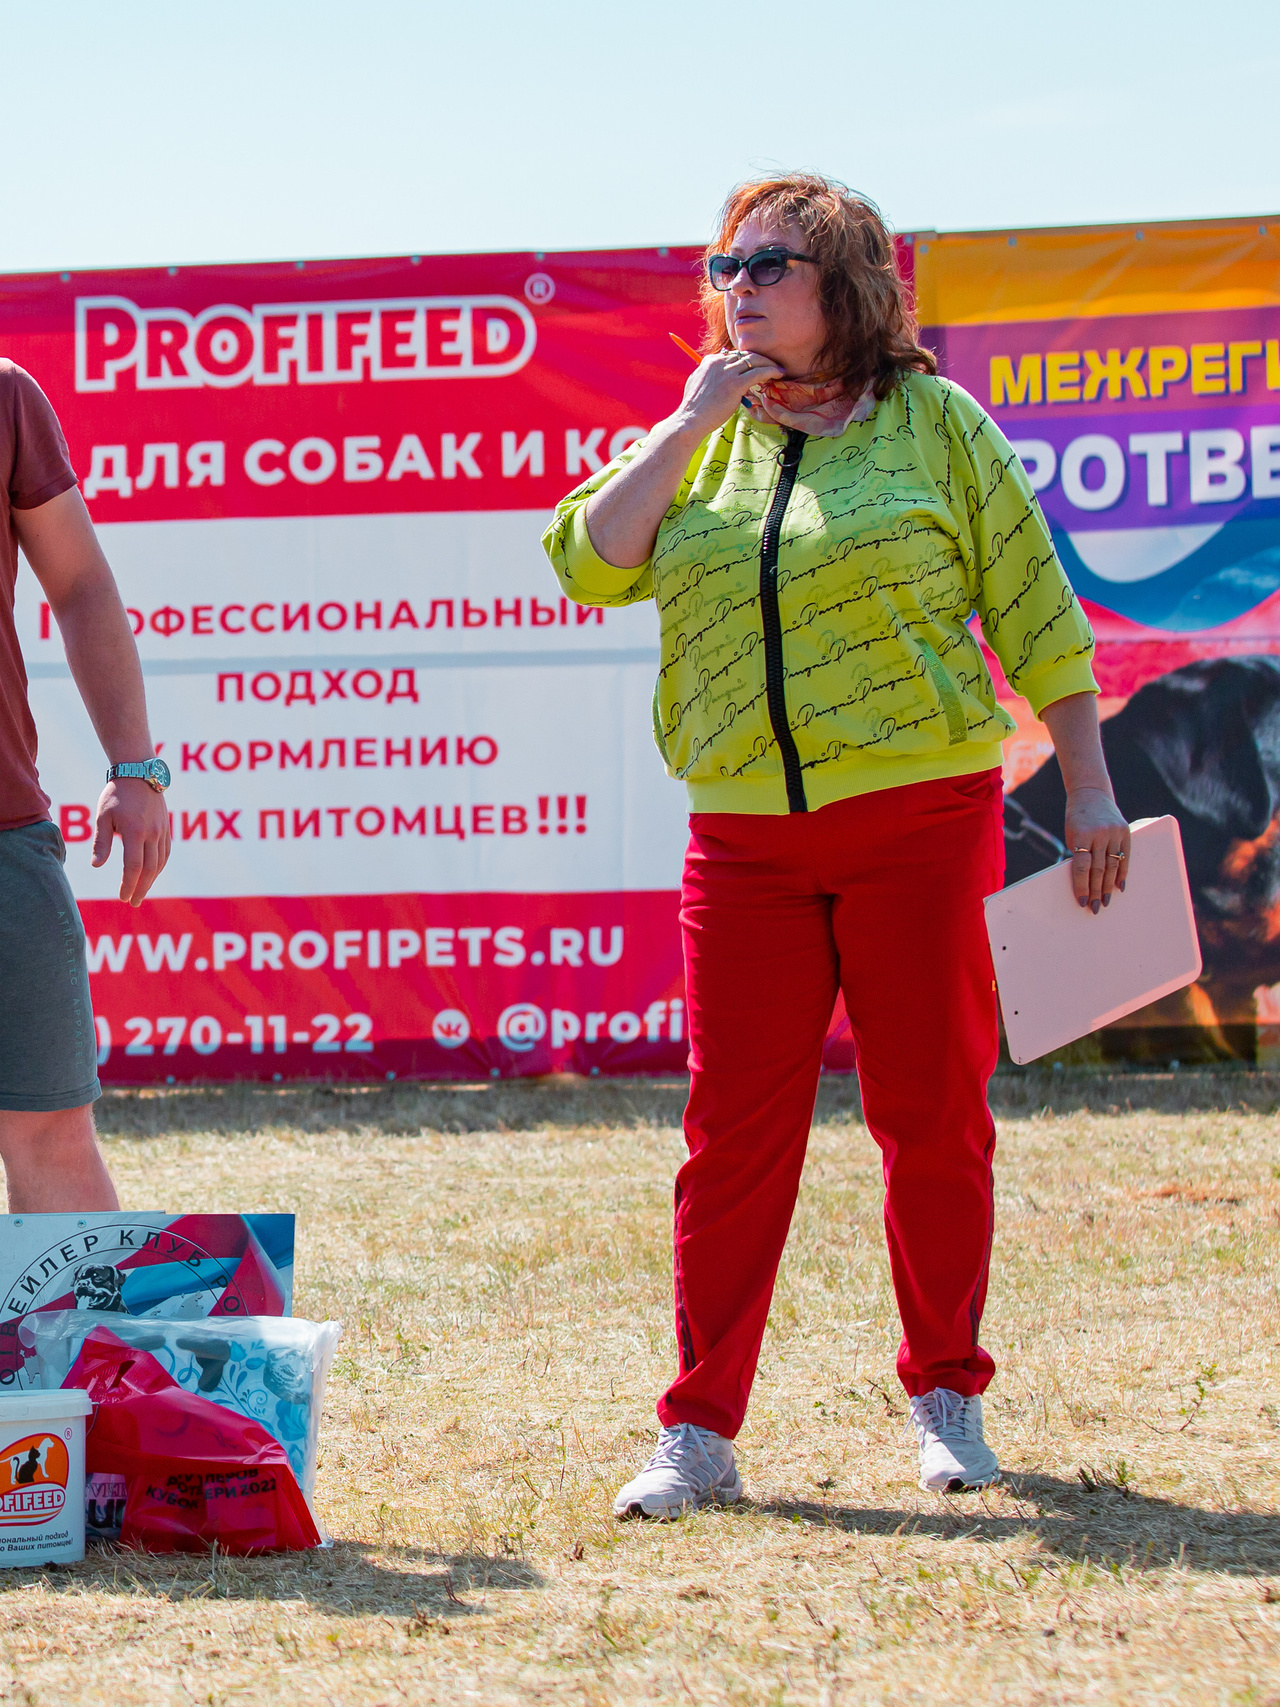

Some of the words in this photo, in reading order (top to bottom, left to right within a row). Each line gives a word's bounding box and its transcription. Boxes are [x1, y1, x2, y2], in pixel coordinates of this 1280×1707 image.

[78, 296, 535, 391] PROFIFEED
[83, 441, 225, 498] ДЛЯ
[244, 432, 484, 486] СОБАК
[501, 430, 545, 477] И
[216, 668, 419, 706] ПОДХОД
[180, 733, 499, 773] КОРМЛЕНИЮ
[58, 803, 242, 844] ВИХ
[258, 794, 588, 841] ПИТОМЦЕВ!!!
[57, 909, 78, 988] ATHLETIC
[124, 1013, 375, 1057] 270-11-22
[119, 1229, 206, 1268] КЛУБ
[7, 1544, 35, 1552] Ваших
[45, 1530, 69, 1541] подход
